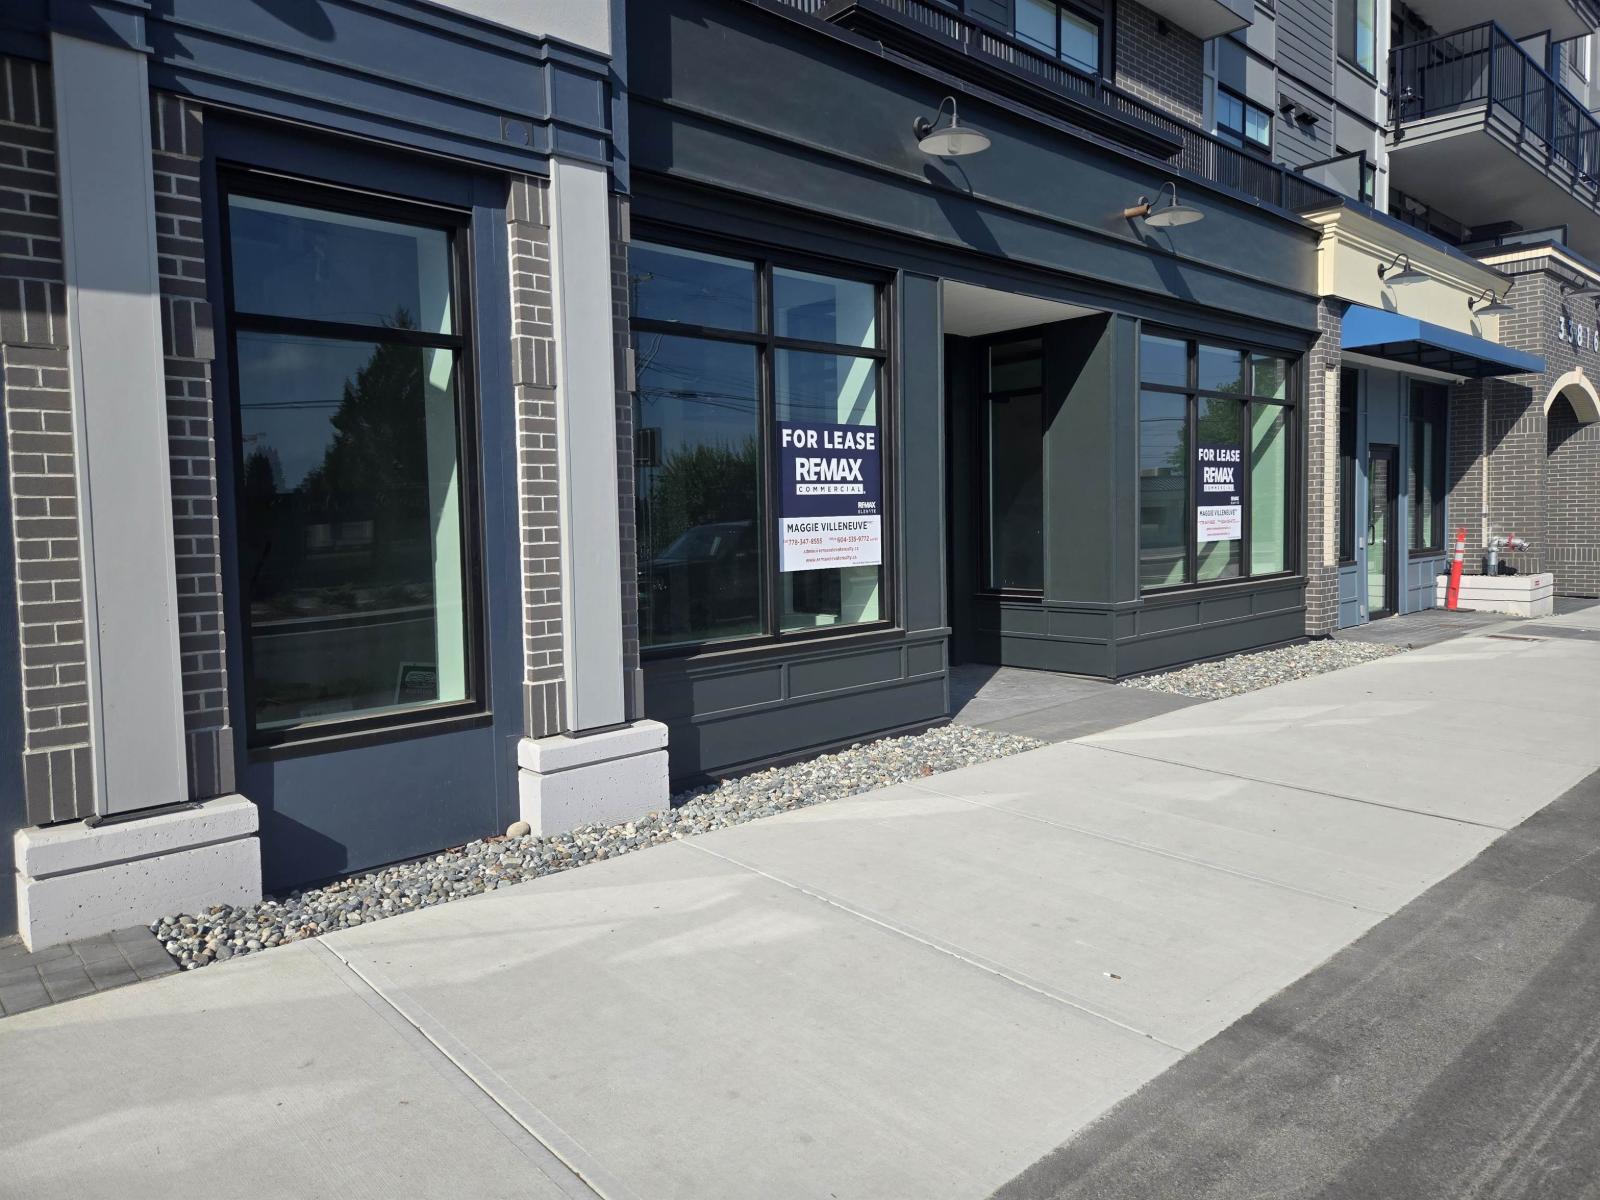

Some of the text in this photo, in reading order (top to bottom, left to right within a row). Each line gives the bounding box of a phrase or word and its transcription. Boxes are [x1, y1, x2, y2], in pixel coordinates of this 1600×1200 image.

[1558, 316, 1599, 353] 33816
[782, 429, 875, 450] FOR LEASE
[1198, 448, 1240, 463] FOR LEASE
[787, 521, 868, 533] MAGGIE VILLENEUVE
